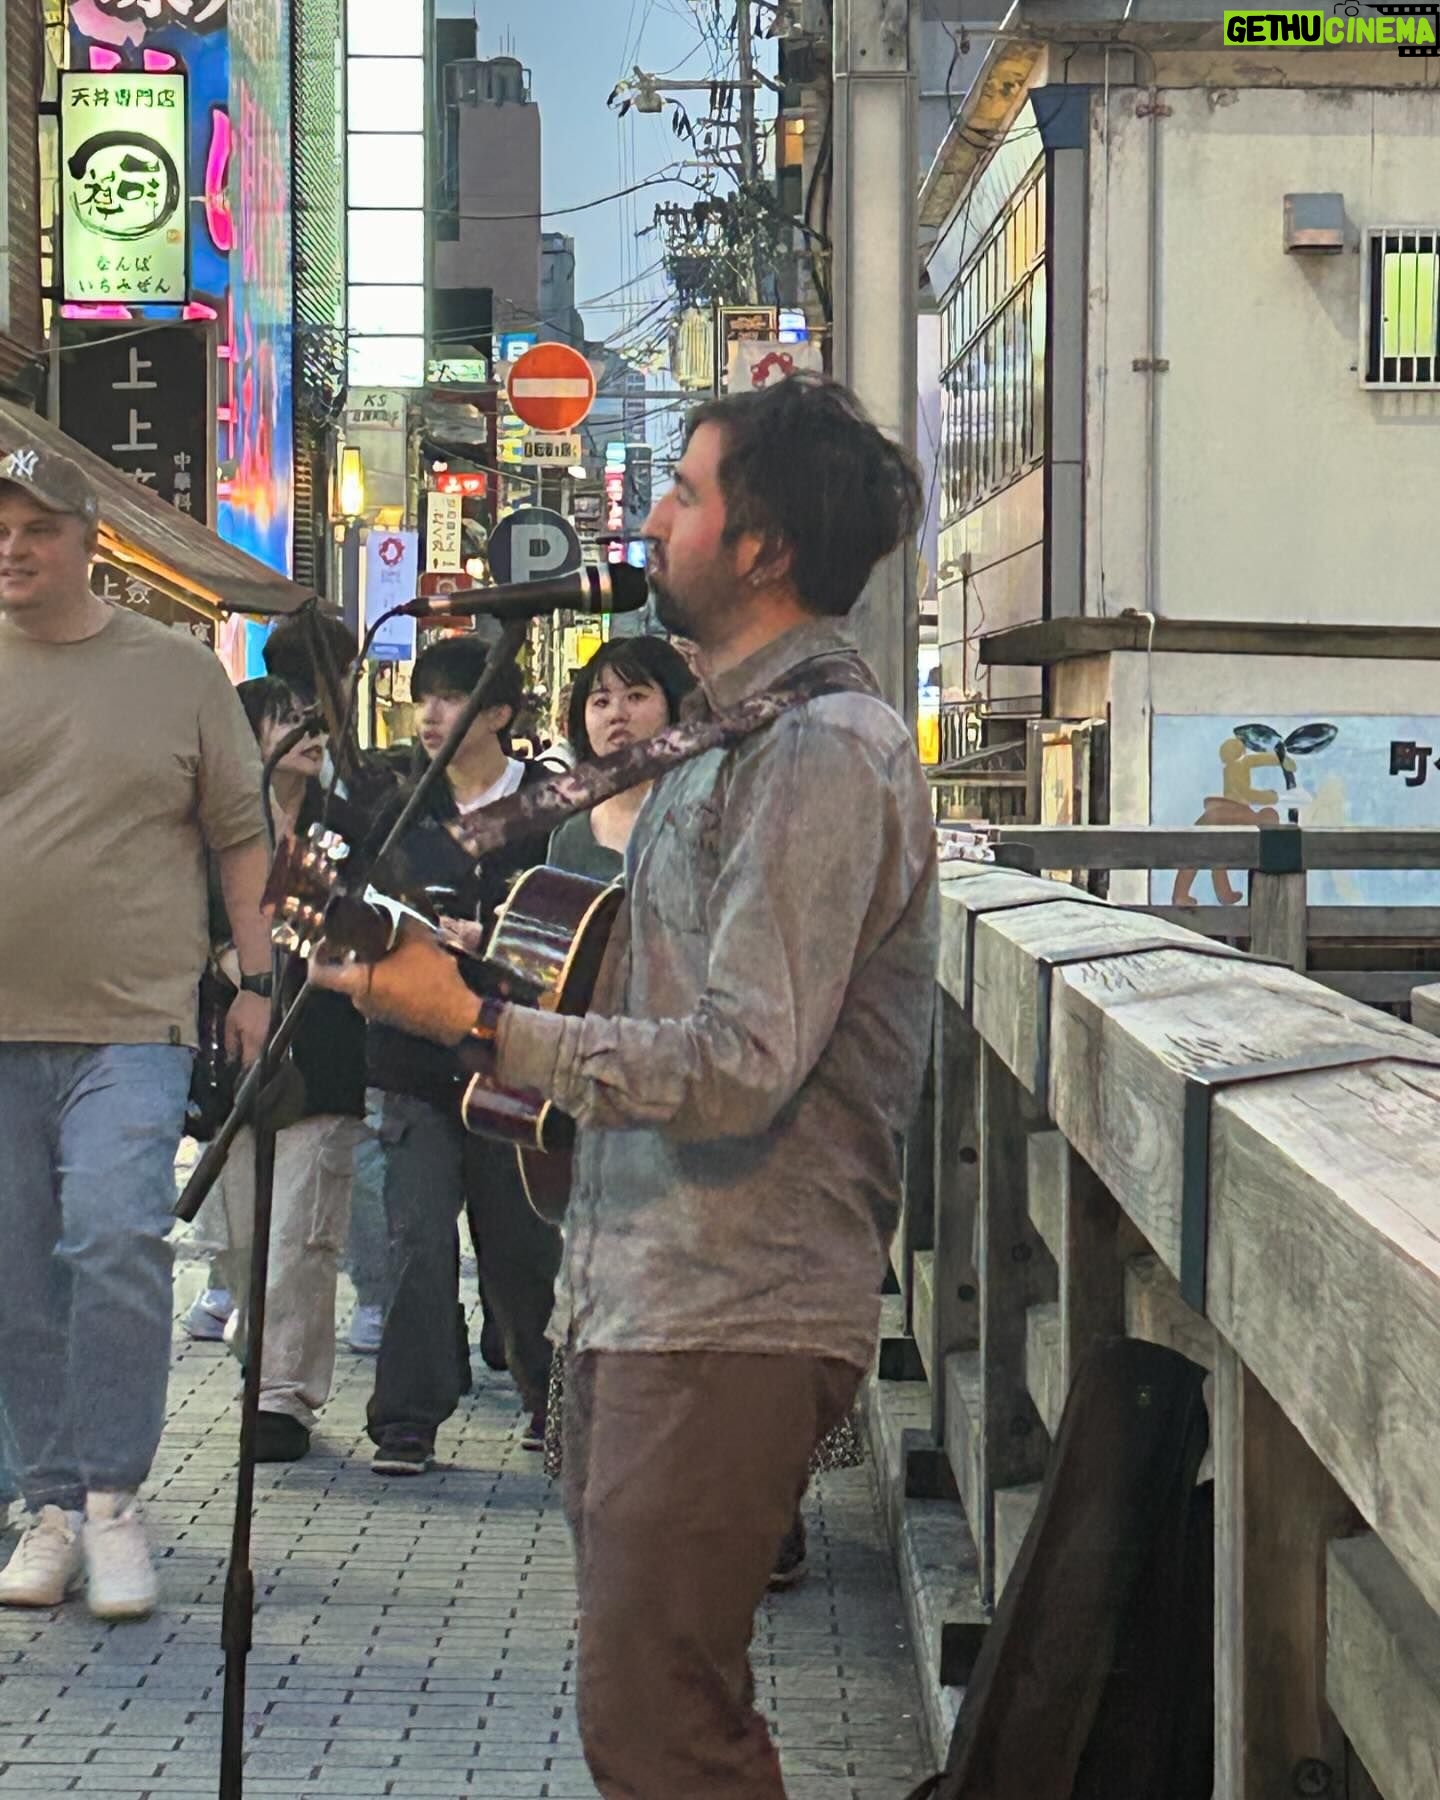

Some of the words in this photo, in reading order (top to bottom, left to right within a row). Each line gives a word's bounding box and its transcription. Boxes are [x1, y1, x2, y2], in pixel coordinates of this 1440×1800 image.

[97, 255, 152, 271] なんば
[7, 449, 40, 482] NY
[511, 524, 571, 583] P
